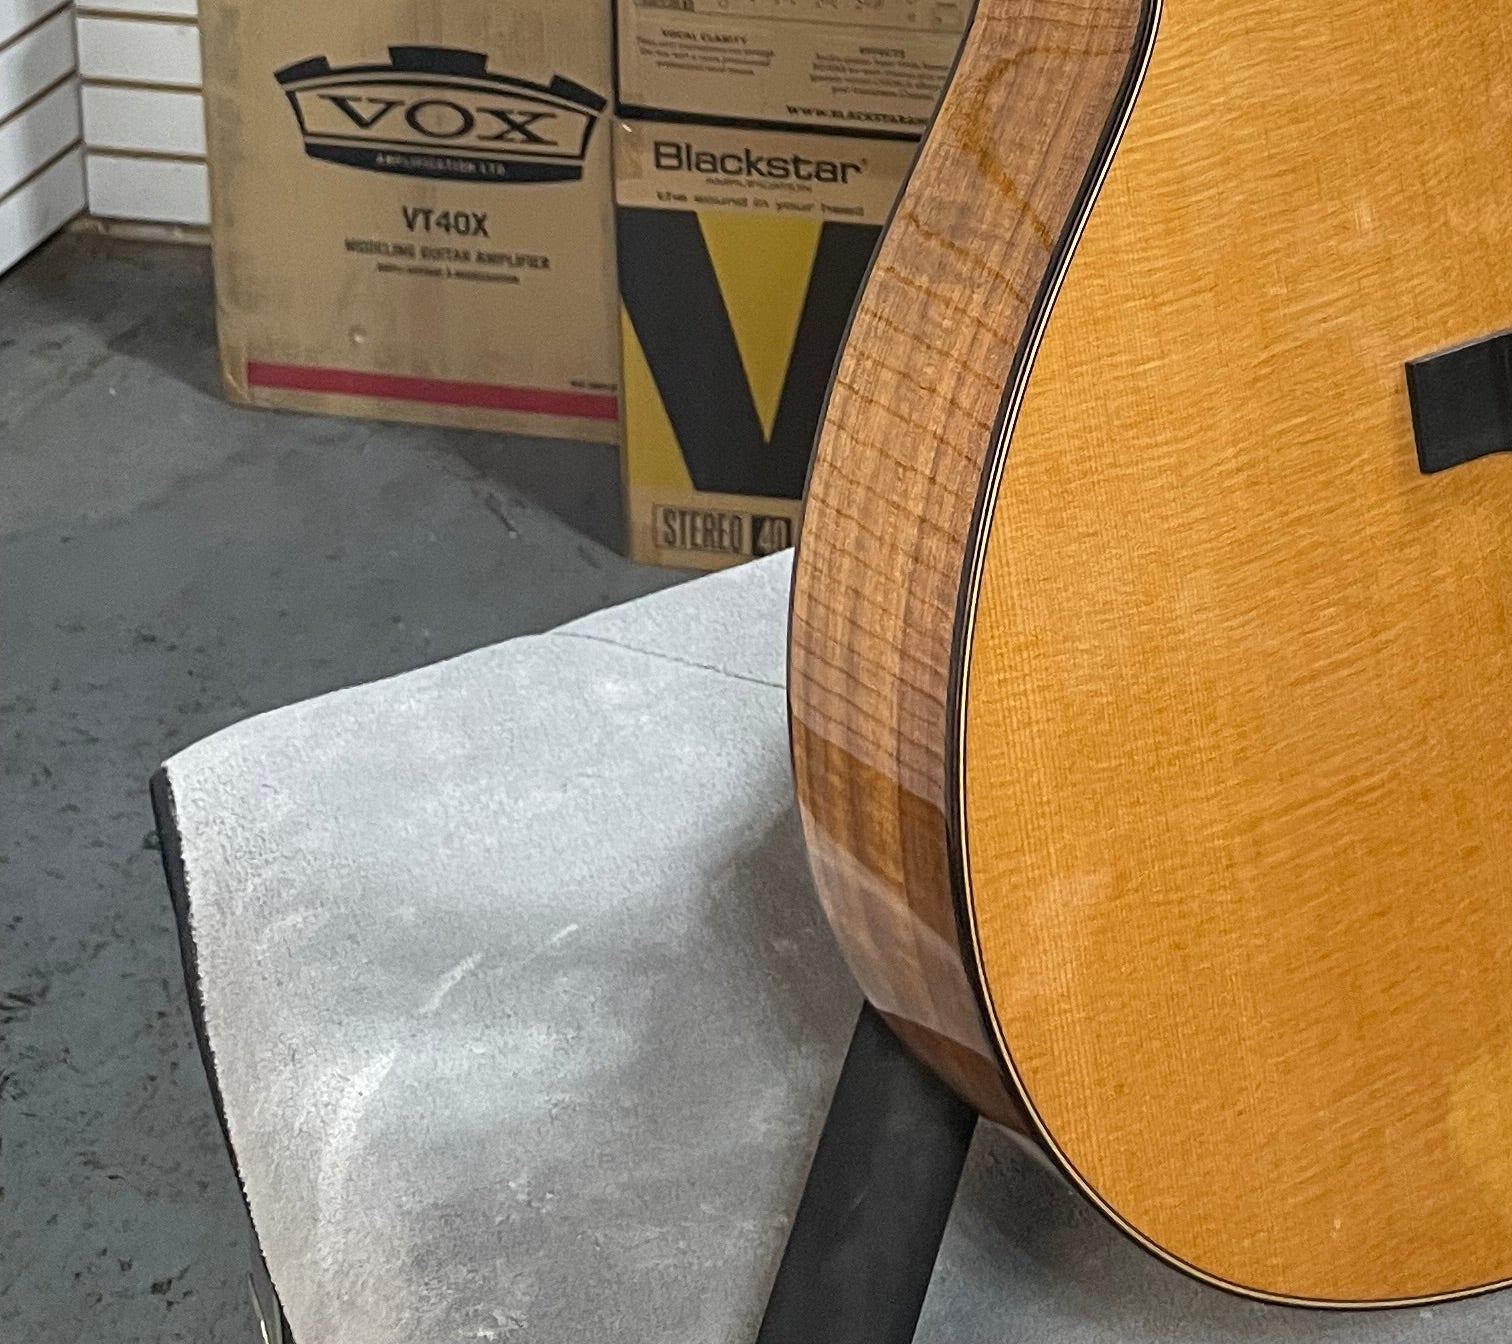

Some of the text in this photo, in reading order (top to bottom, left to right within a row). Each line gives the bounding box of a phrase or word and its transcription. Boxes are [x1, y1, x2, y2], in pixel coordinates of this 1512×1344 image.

[318, 94, 559, 147] VOX
[653, 140, 864, 185] Blackstar
[402, 204, 491, 239] VT40X
[662, 507, 743, 554] STEREO
